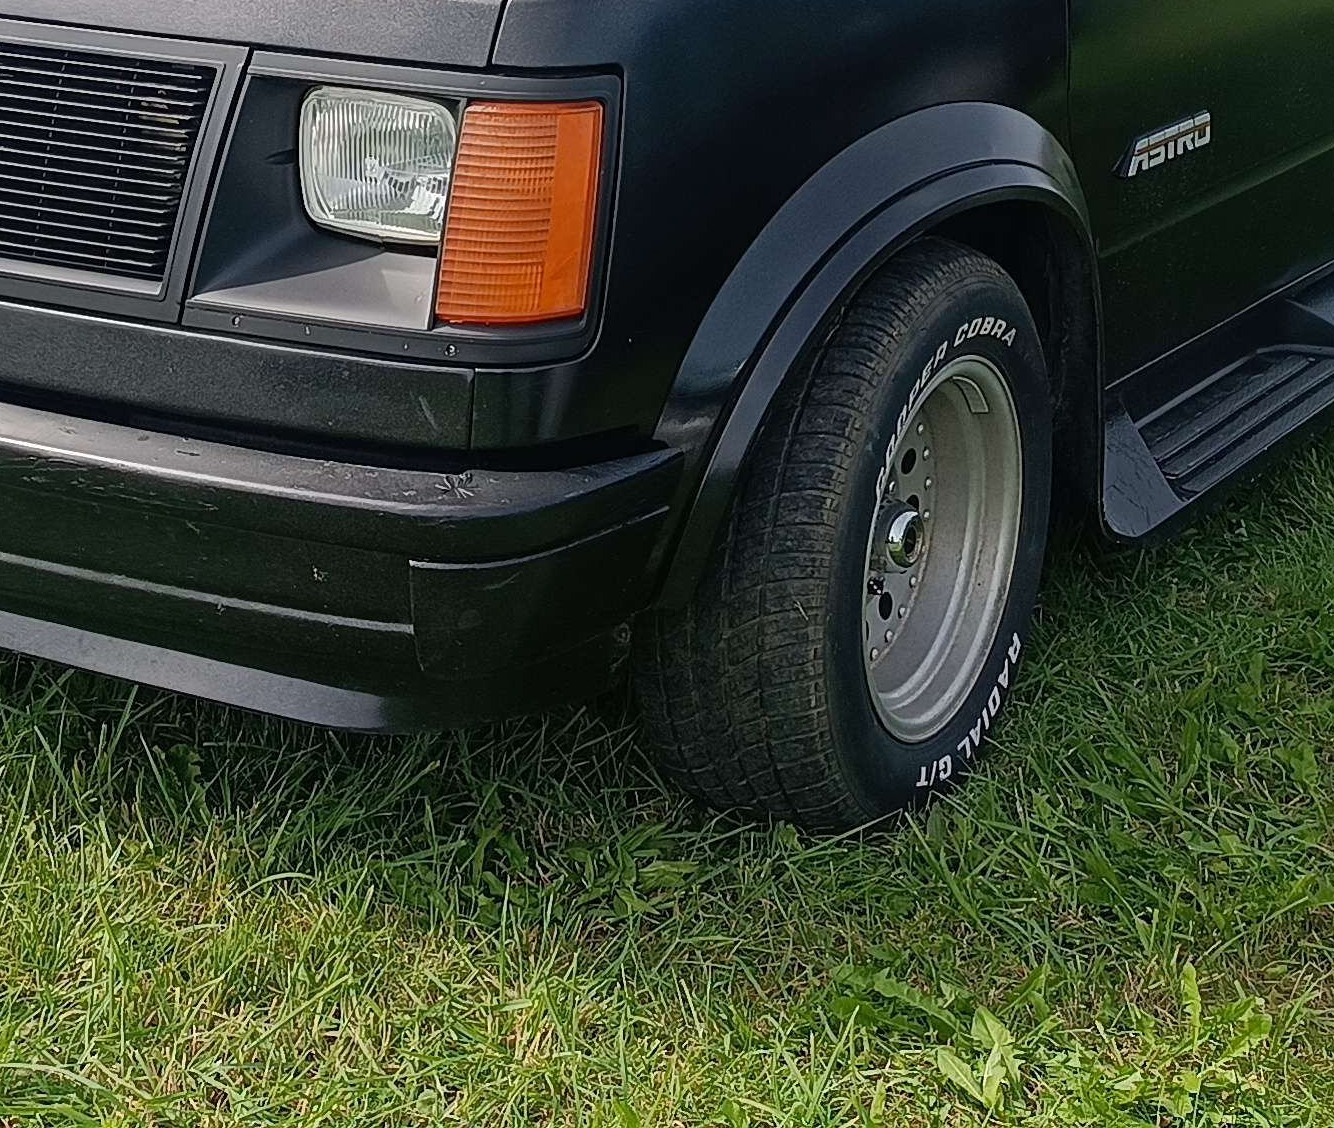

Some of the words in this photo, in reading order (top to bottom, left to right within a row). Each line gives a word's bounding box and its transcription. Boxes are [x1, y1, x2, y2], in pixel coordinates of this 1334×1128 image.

[1127, 112, 1211, 177] ASTRO
[953, 316, 1017, 348] COBRA
[957, 632, 1021, 760] RADIAL
[916, 754, 952, 787] G/T
